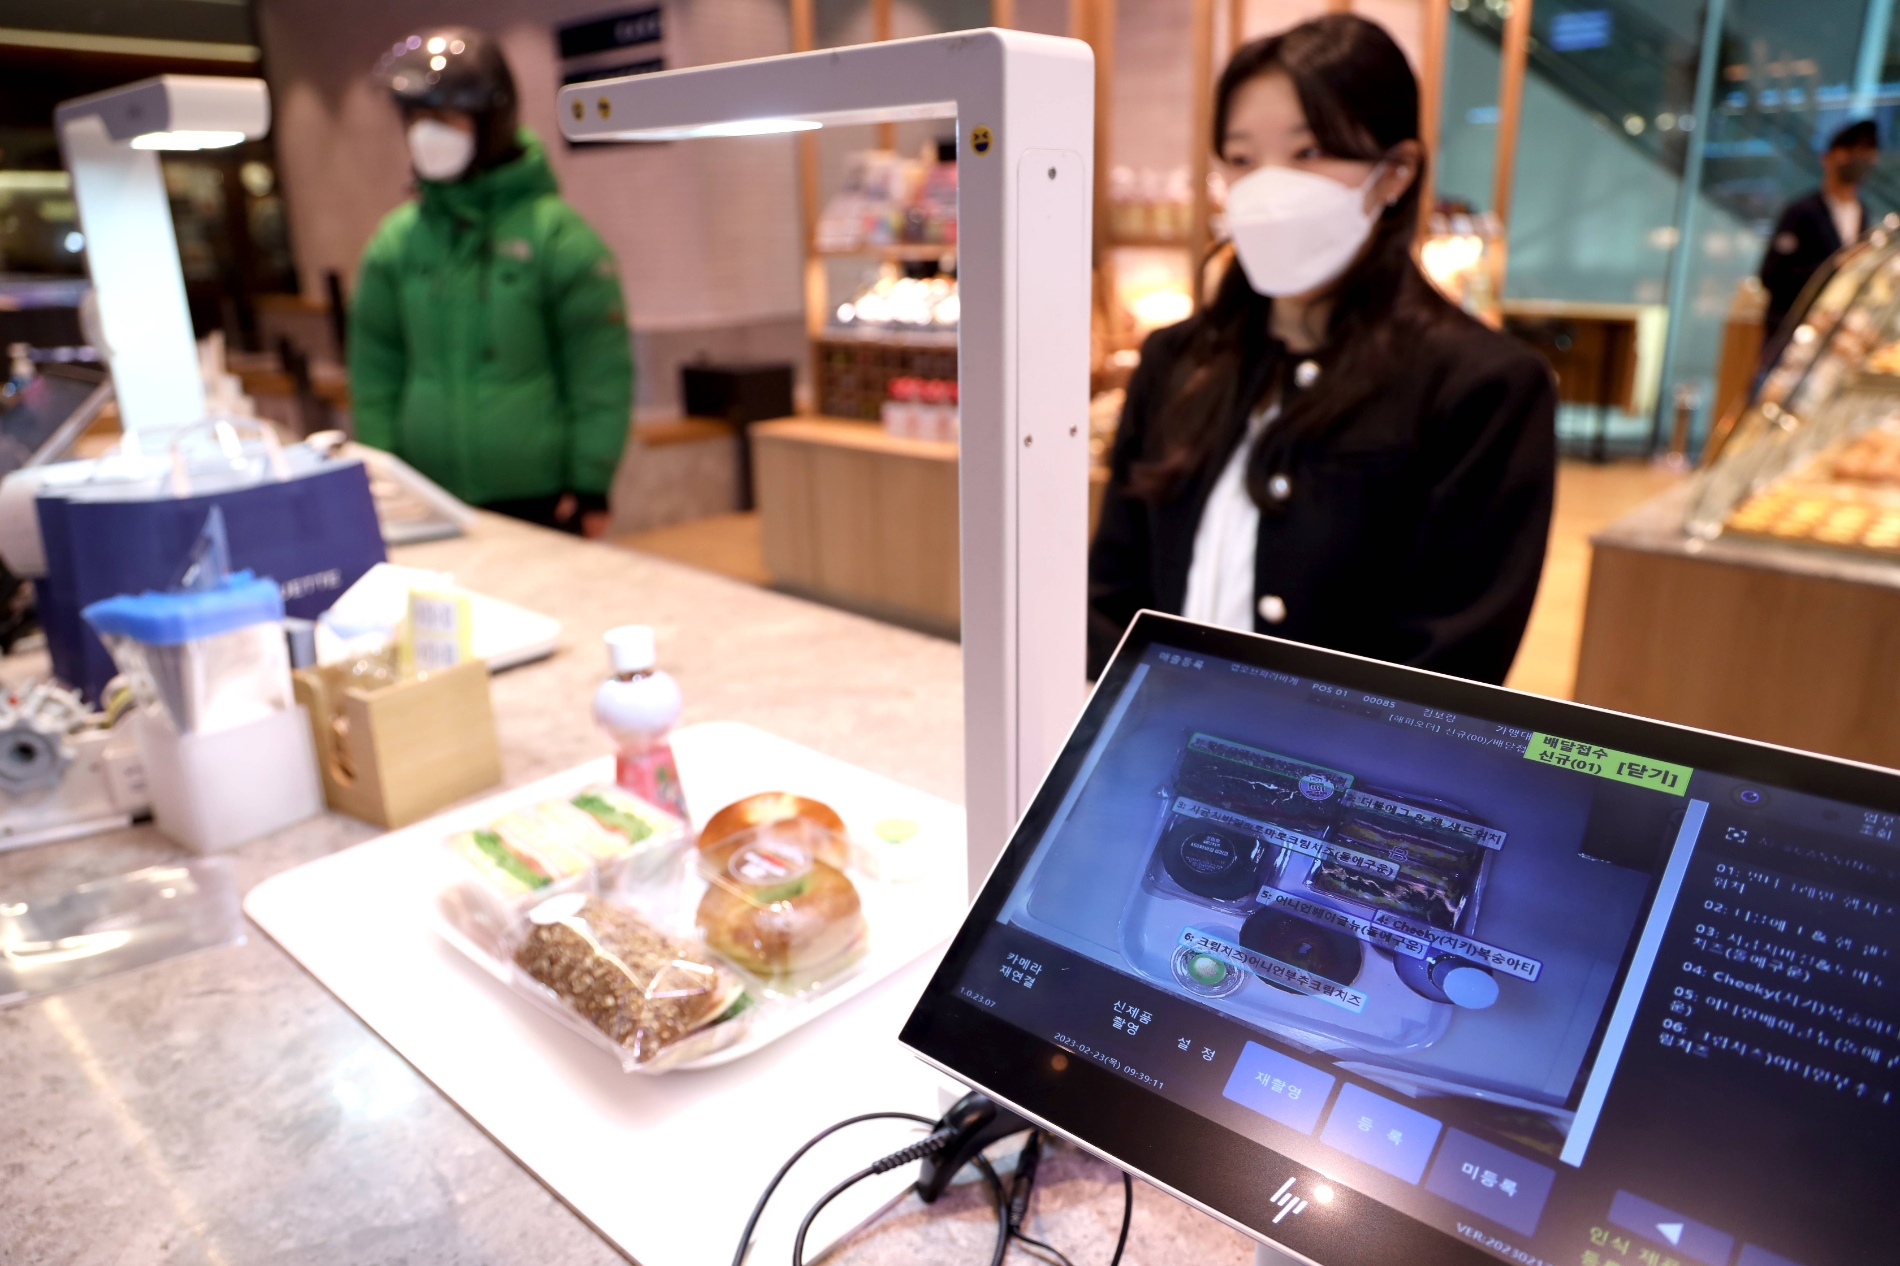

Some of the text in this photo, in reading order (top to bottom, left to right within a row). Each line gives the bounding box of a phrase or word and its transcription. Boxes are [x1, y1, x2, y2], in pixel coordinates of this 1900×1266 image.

[1312, 683, 1332, 694] POS
[1335, 688, 1348, 697] 01
[1362, 695, 1396, 709] 00085
[1543, 735, 1608, 759] 배달접수
[1539, 750, 1679, 788] 신규(01) [닫기]
[1261, 890, 1272, 900] 5:
[1377, 916, 1388, 926] 4:
[1184, 932, 1195, 942] 6:
[1006, 951, 1042, 976] 카메라
[999, 964, 1036, 989] 재연결
[960, 986, 996, 1008] 1.0.23.07
[1113, 1000, 1153, 1025] 신제품
[1112, 1015, 1139, 1036] 촬영
[1054, 1032, 1165, 1090] 2023-02-23(목) 09:39:11
[1255, 1071, 1302, 1100] 재촬영
[1461, 1162, 1518, 1198] 미등록
[1457, 1222, 1554, 1266] VER:2023021
